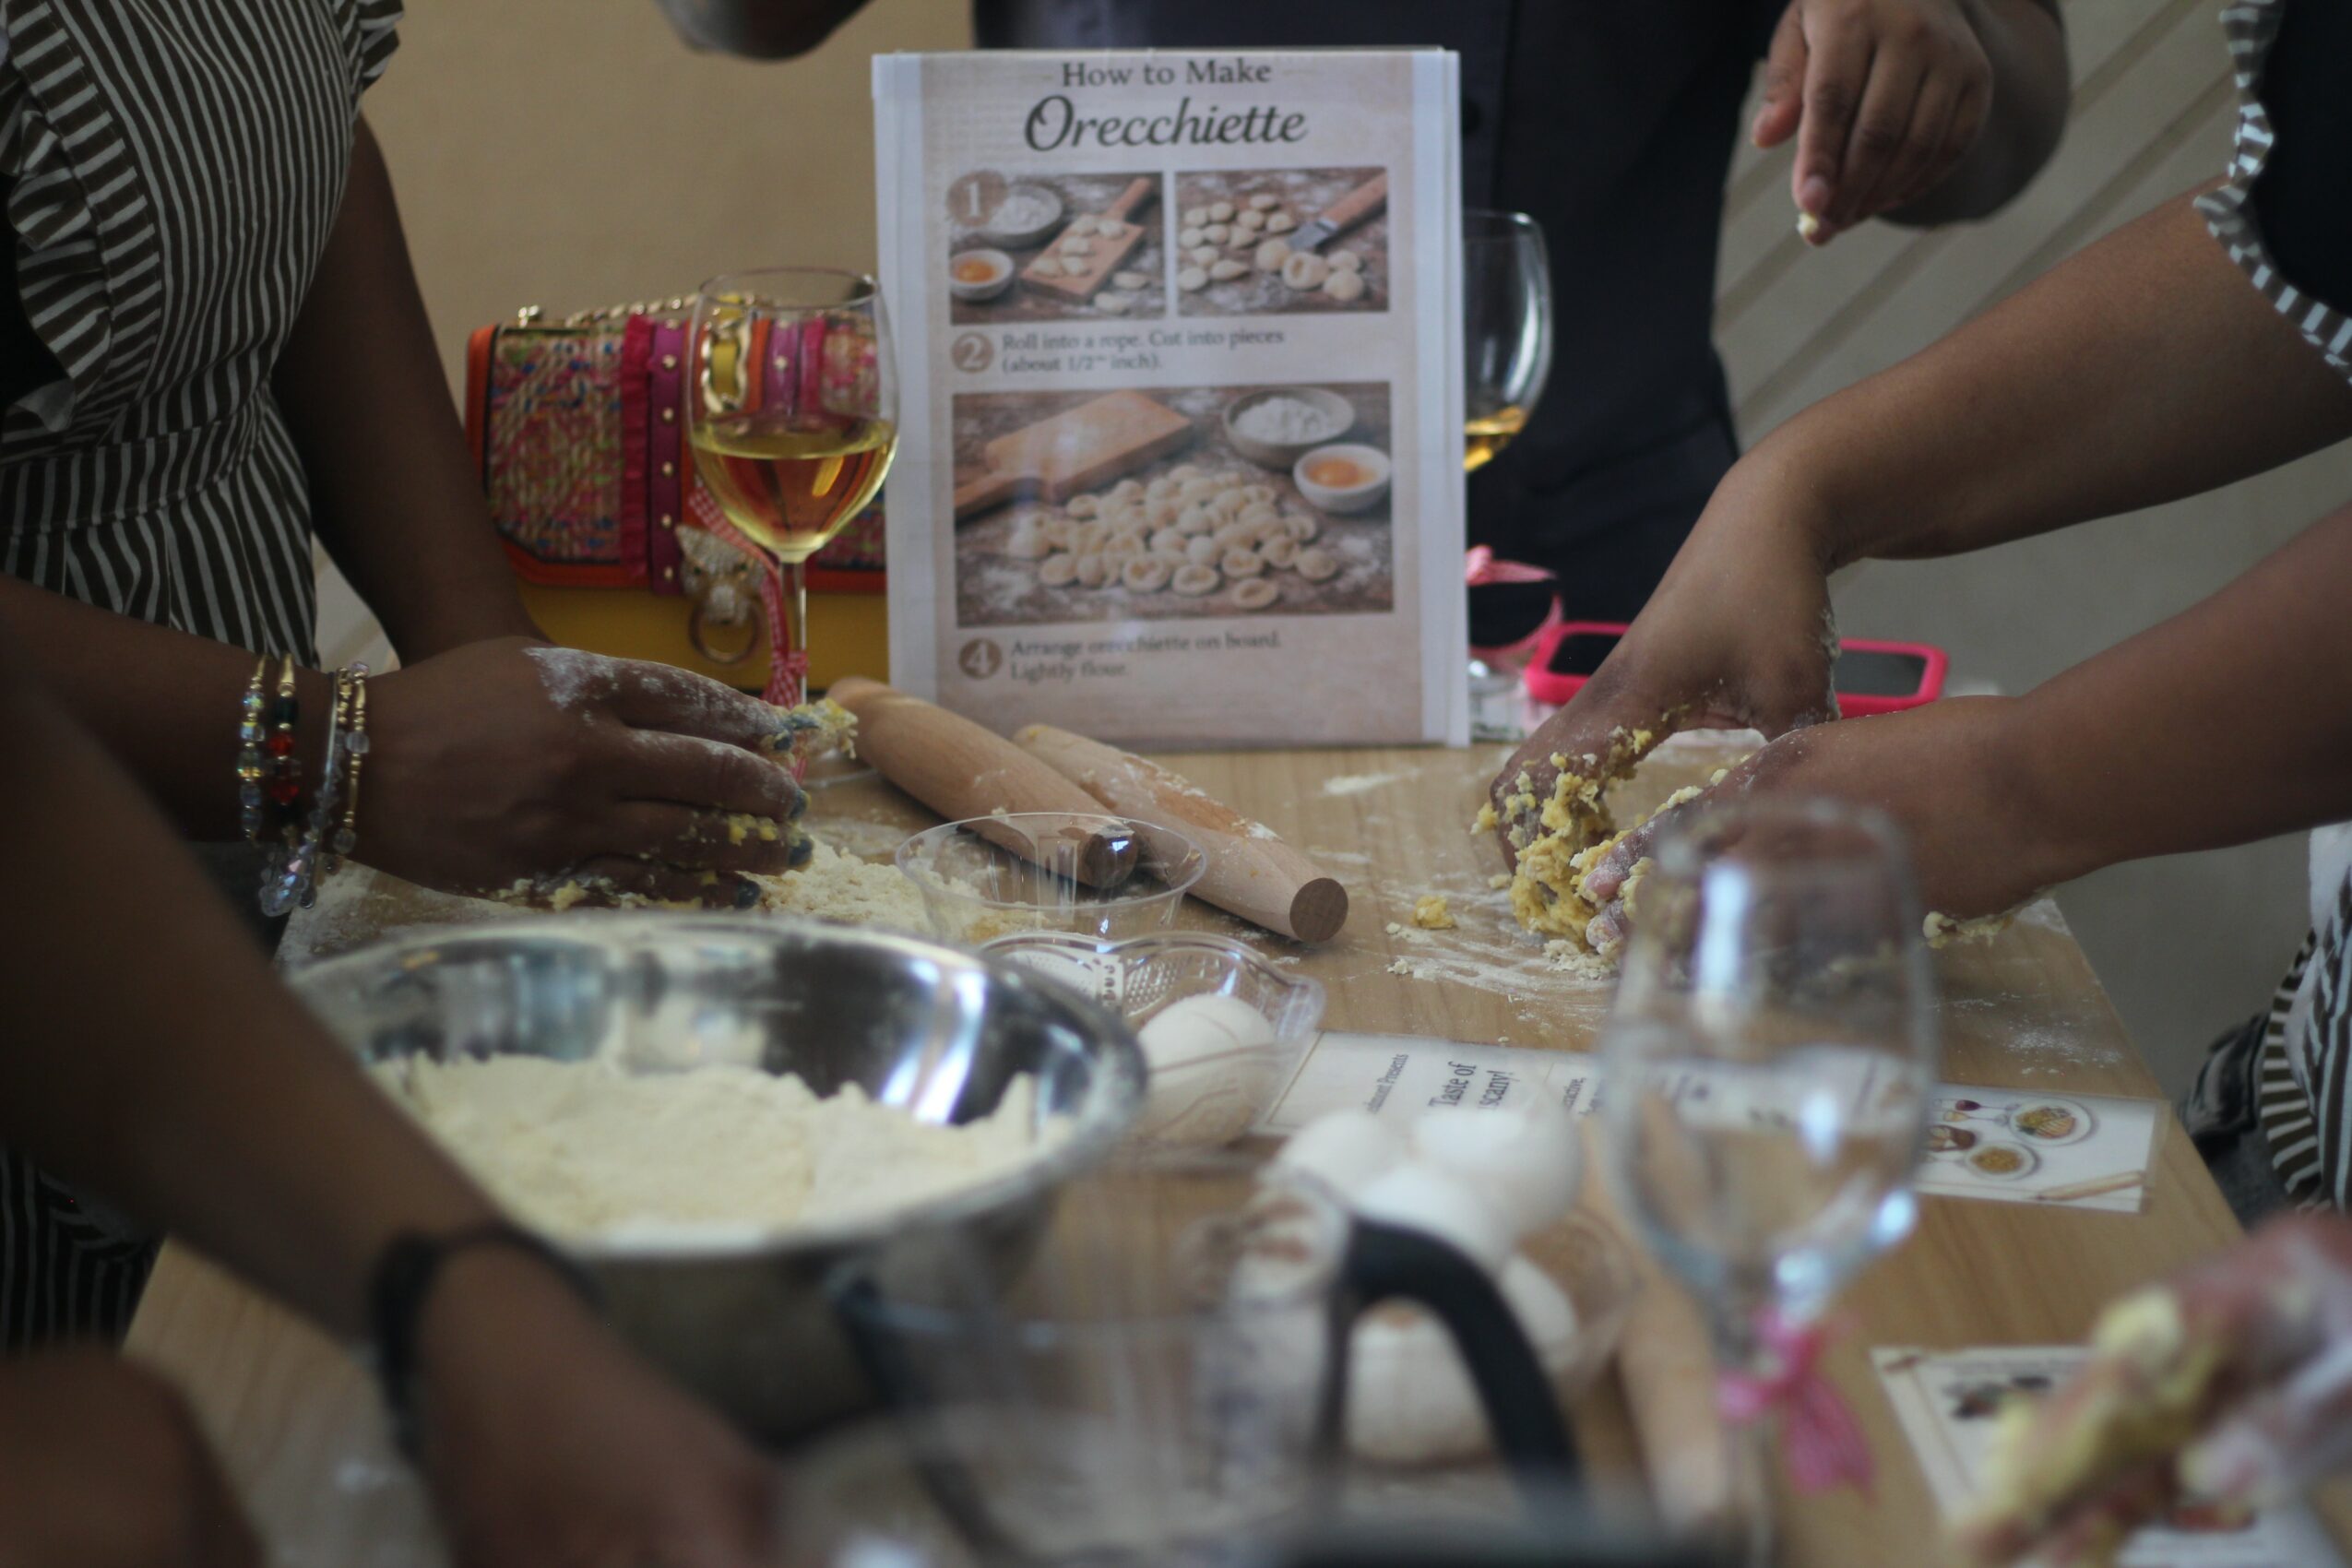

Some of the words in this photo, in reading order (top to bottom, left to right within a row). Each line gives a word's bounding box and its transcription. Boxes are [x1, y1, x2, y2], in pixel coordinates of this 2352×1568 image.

[1062, 62, 1133, 88] How
[1144, 63, 1176, 86] to
[1185, 57, 1273, 85] Make
[1024, 94, 1309, 152] Orecchiette
[1003, 334, 1039, 351] Roll
[1042, 332, 1080, 350] into
[1083, 336, 1095, 349] a
[1149, 329, 1182, 347] Cut
[1187, 331, 1225, 346] into
[1228, 328, 1285, 350] pieces
[1002, 355, 1061, 374] (about
[1011, 639, 1082, 659] Arrange
[1194, 636, 1220, 650] on
[1011, 659, 1075, 683] Lightly
[1448, 1061, 1477, 1077] of
[1428, 1077, 1469, 1106] Taste
[1478, 1070, 1520, 1109] scany!
